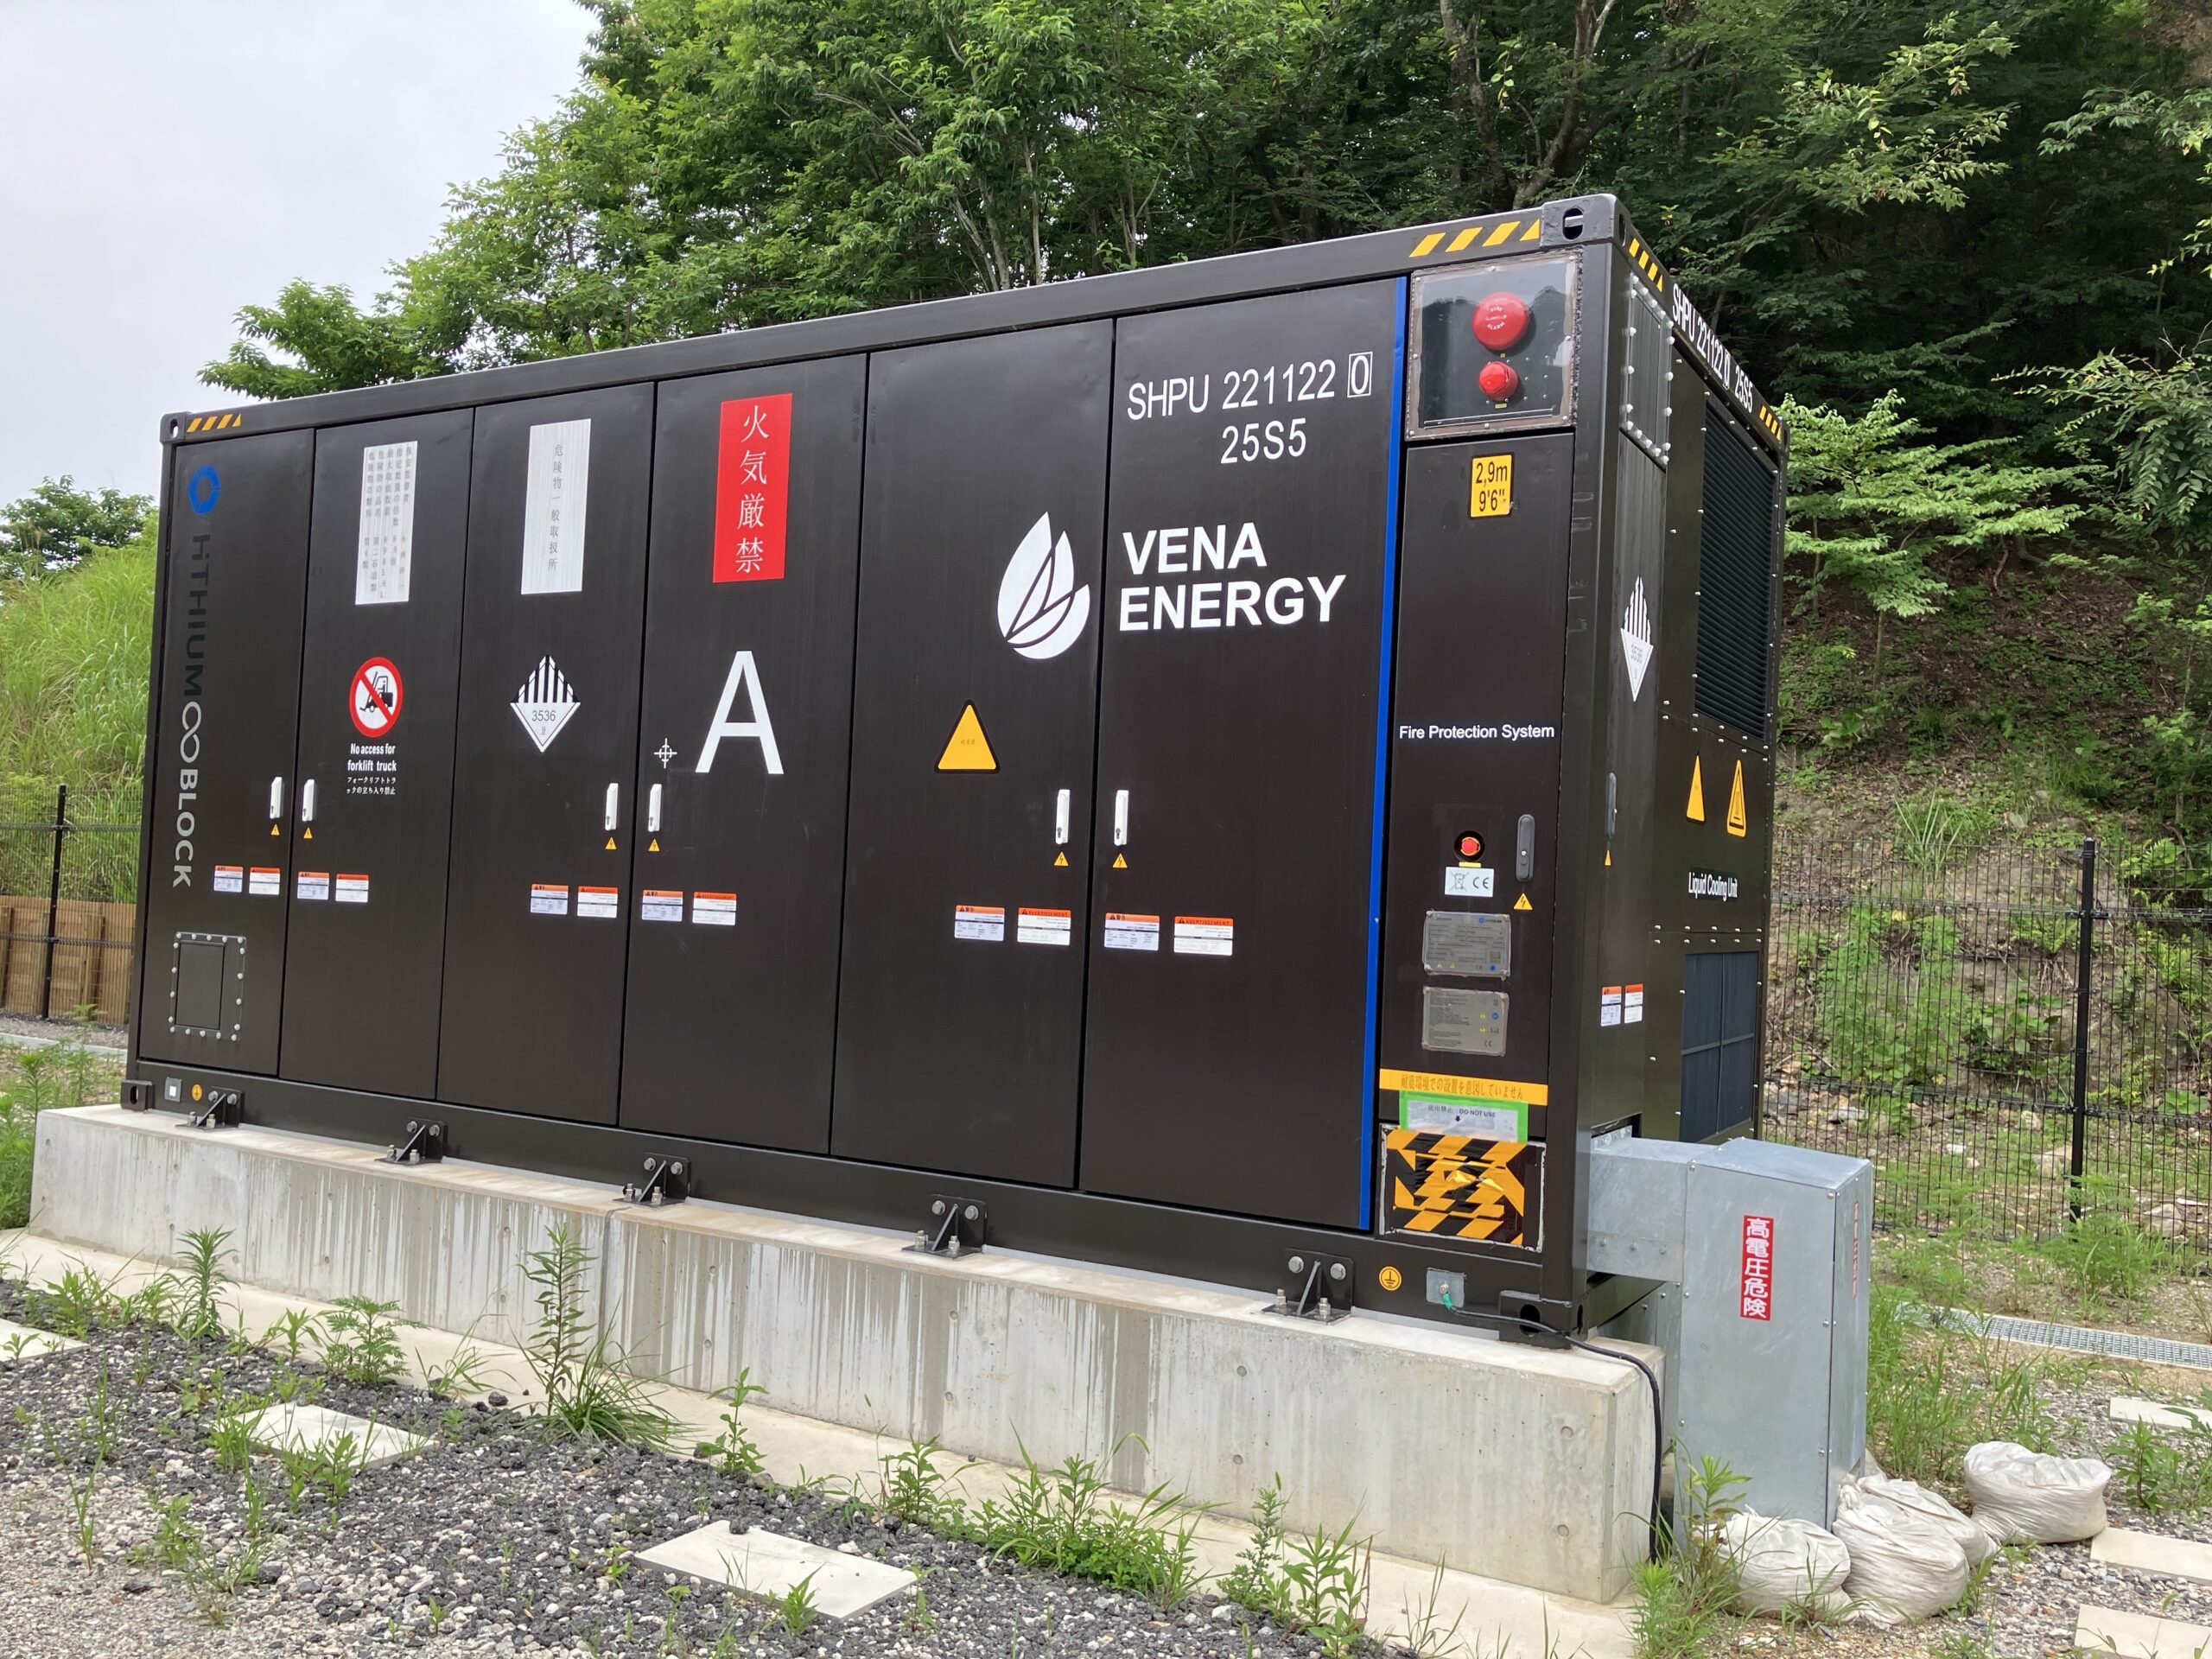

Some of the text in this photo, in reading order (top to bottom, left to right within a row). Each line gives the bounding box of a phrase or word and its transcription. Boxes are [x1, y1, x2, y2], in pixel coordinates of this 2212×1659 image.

[1672, 283, 1695, 342] SHPU
[1696, 316, 1723, 378] 221122
[1127, 374, 1209, 421] SHPU
[1222, 359, 1336, 410] 221122
[1734, 365, 1753, 413] 25S5
[1220, 418, 1306, 463] 25S5
[735, 404, 770, 574] 火気厳禁
[1476, 461, 1508, 488] 2,9m
[1122, 522, 1268, 575] VENA
[1119, 574, 1347, 632] ENERGY
[531, 709, 556, 721] 3536
[695, 651, 784, 774] A
[1399, 723, 1554, 741] Fire Protection System
[347, 759, 397, 771] forklift truck
[350, 742, 396, 754] No access for
[173, 768, 199, 888] BLOCK
[1688, 872, 1738, 902] Liquid Cooling Unit
[1743, 1217, 1770, 1319] 高電圧危険
